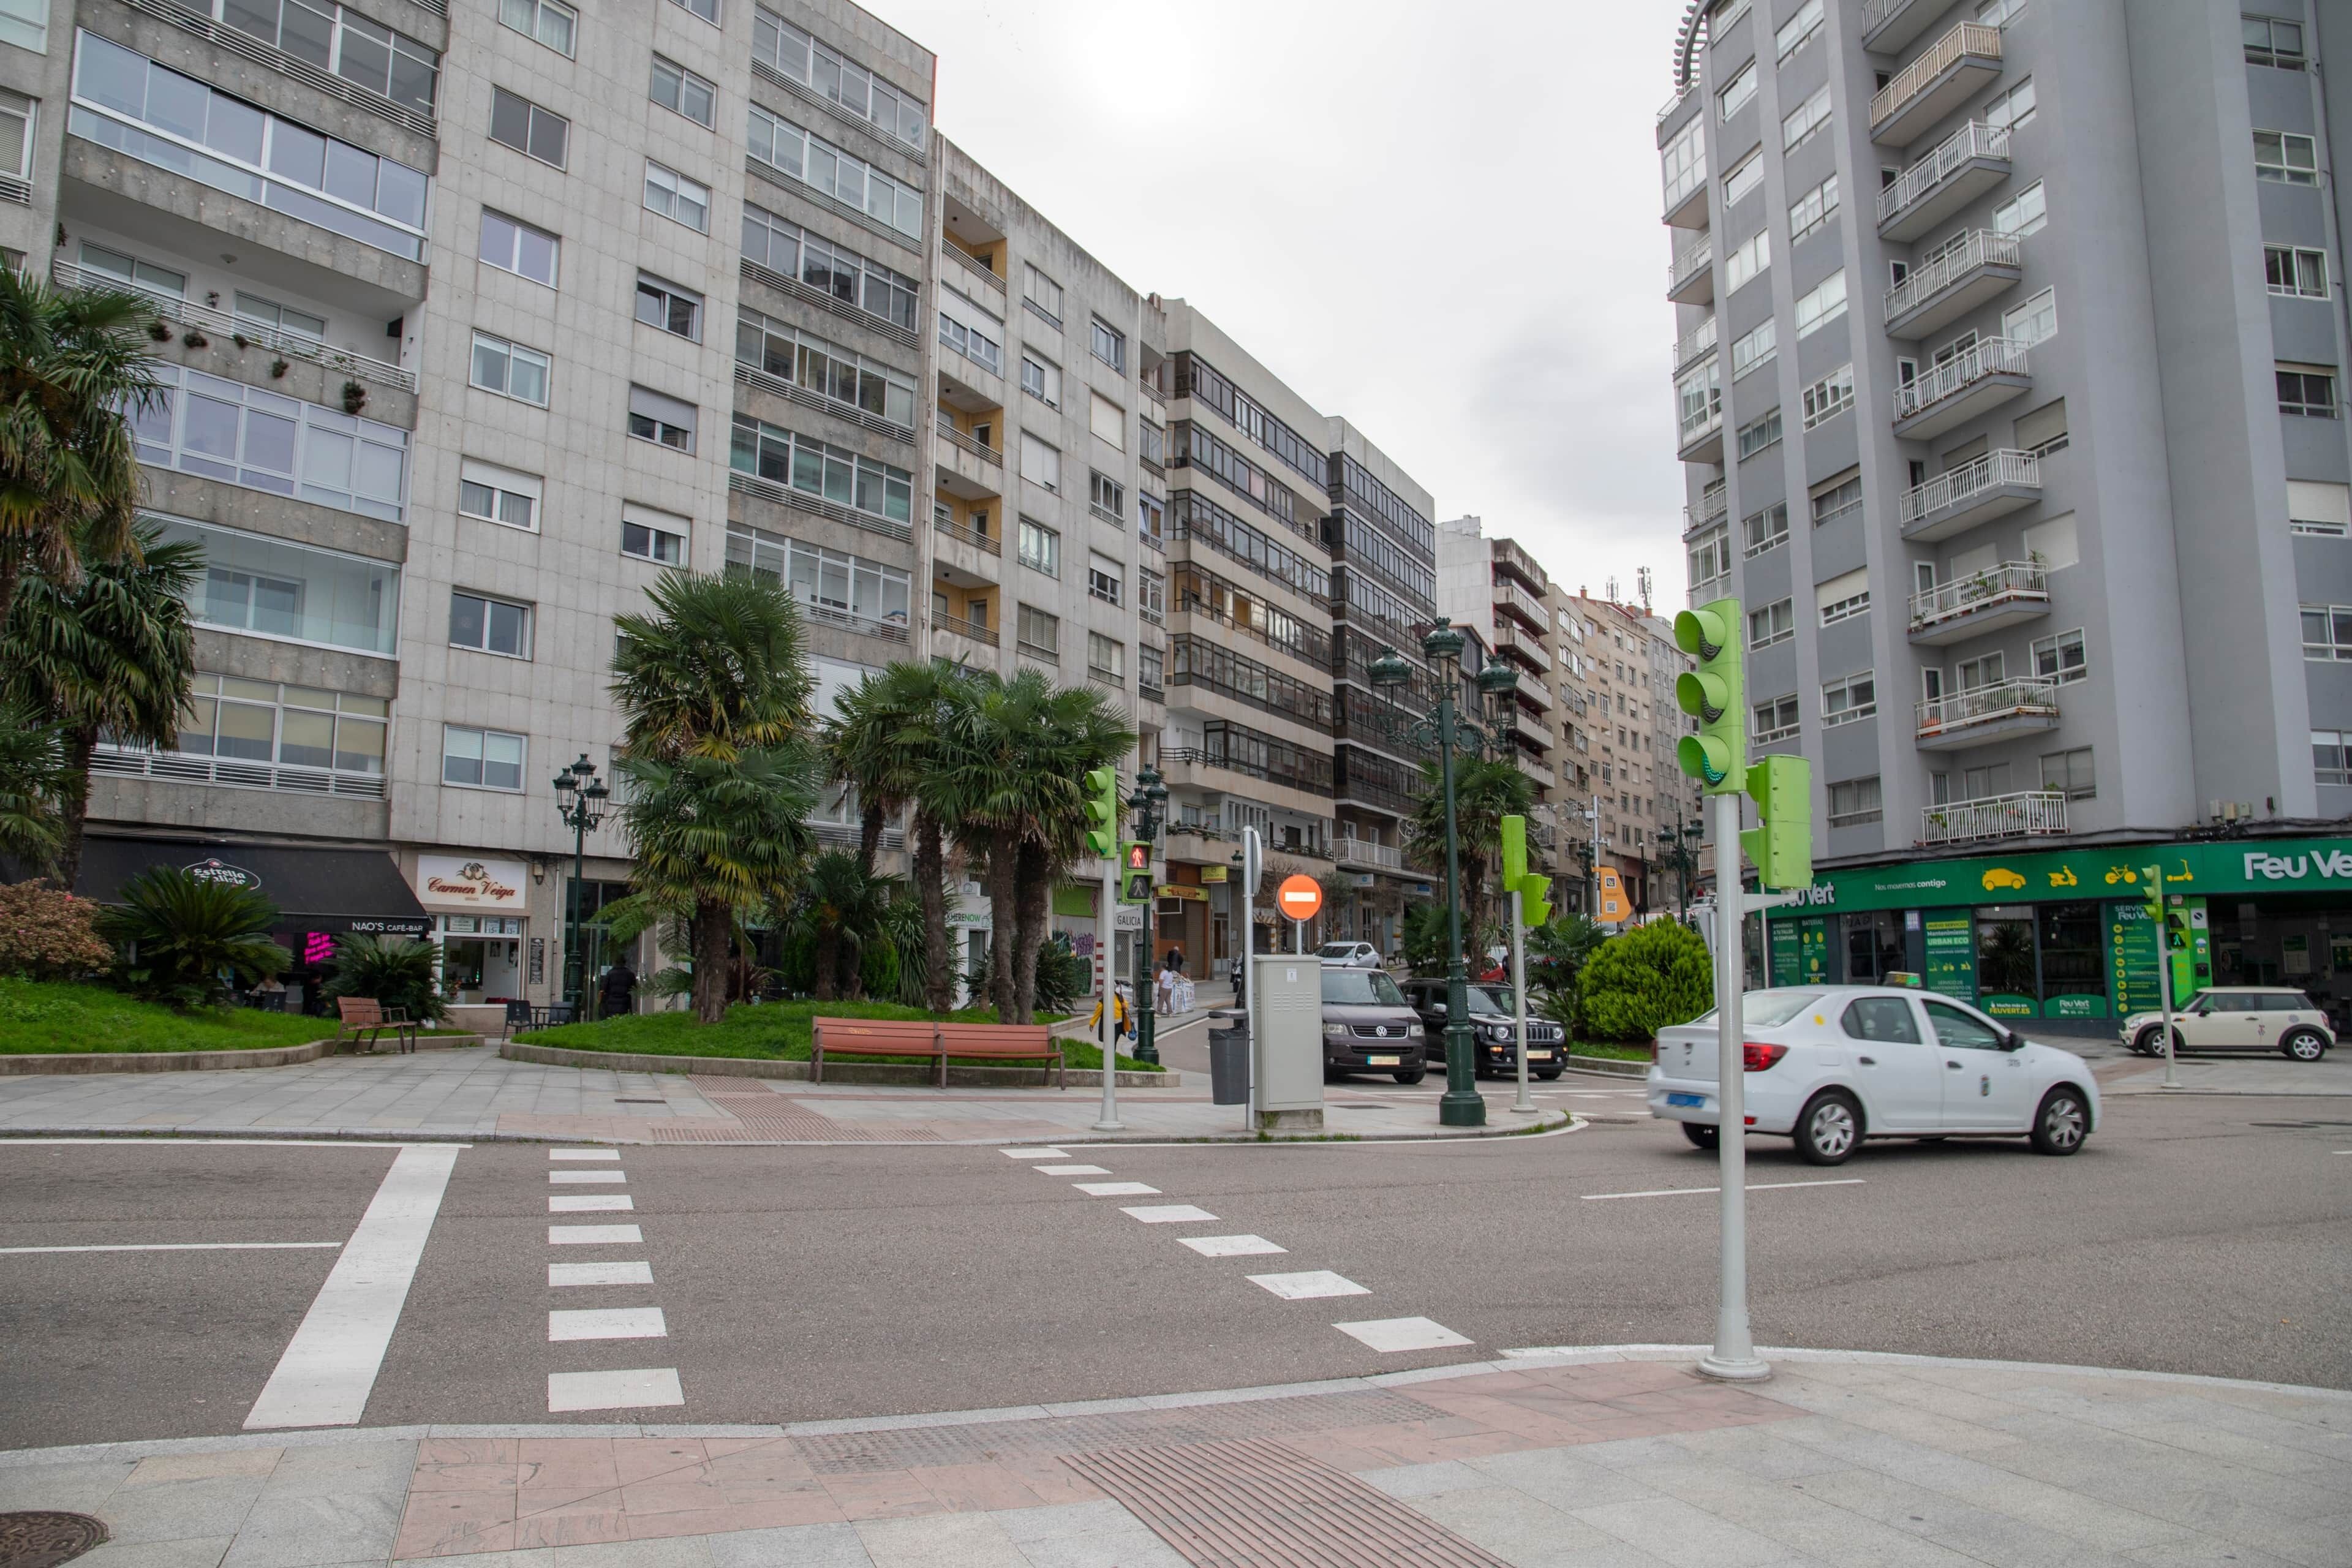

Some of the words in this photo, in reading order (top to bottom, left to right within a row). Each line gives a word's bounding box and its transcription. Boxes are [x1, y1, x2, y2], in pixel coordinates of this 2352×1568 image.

[2244, 852, 2307, 880] Feu
[194, 868, 246, 879] Estrella
[428, 877, 476, 894] Carmen
[481, 881, 516, 900] Veiga
[1917, 878, 1946, 888] contigo
[1807, 881, 1834, 905] Vert
[1117, 914, 1141, 926] GALICIA
[2118, 912, 2136, 921] Feu
